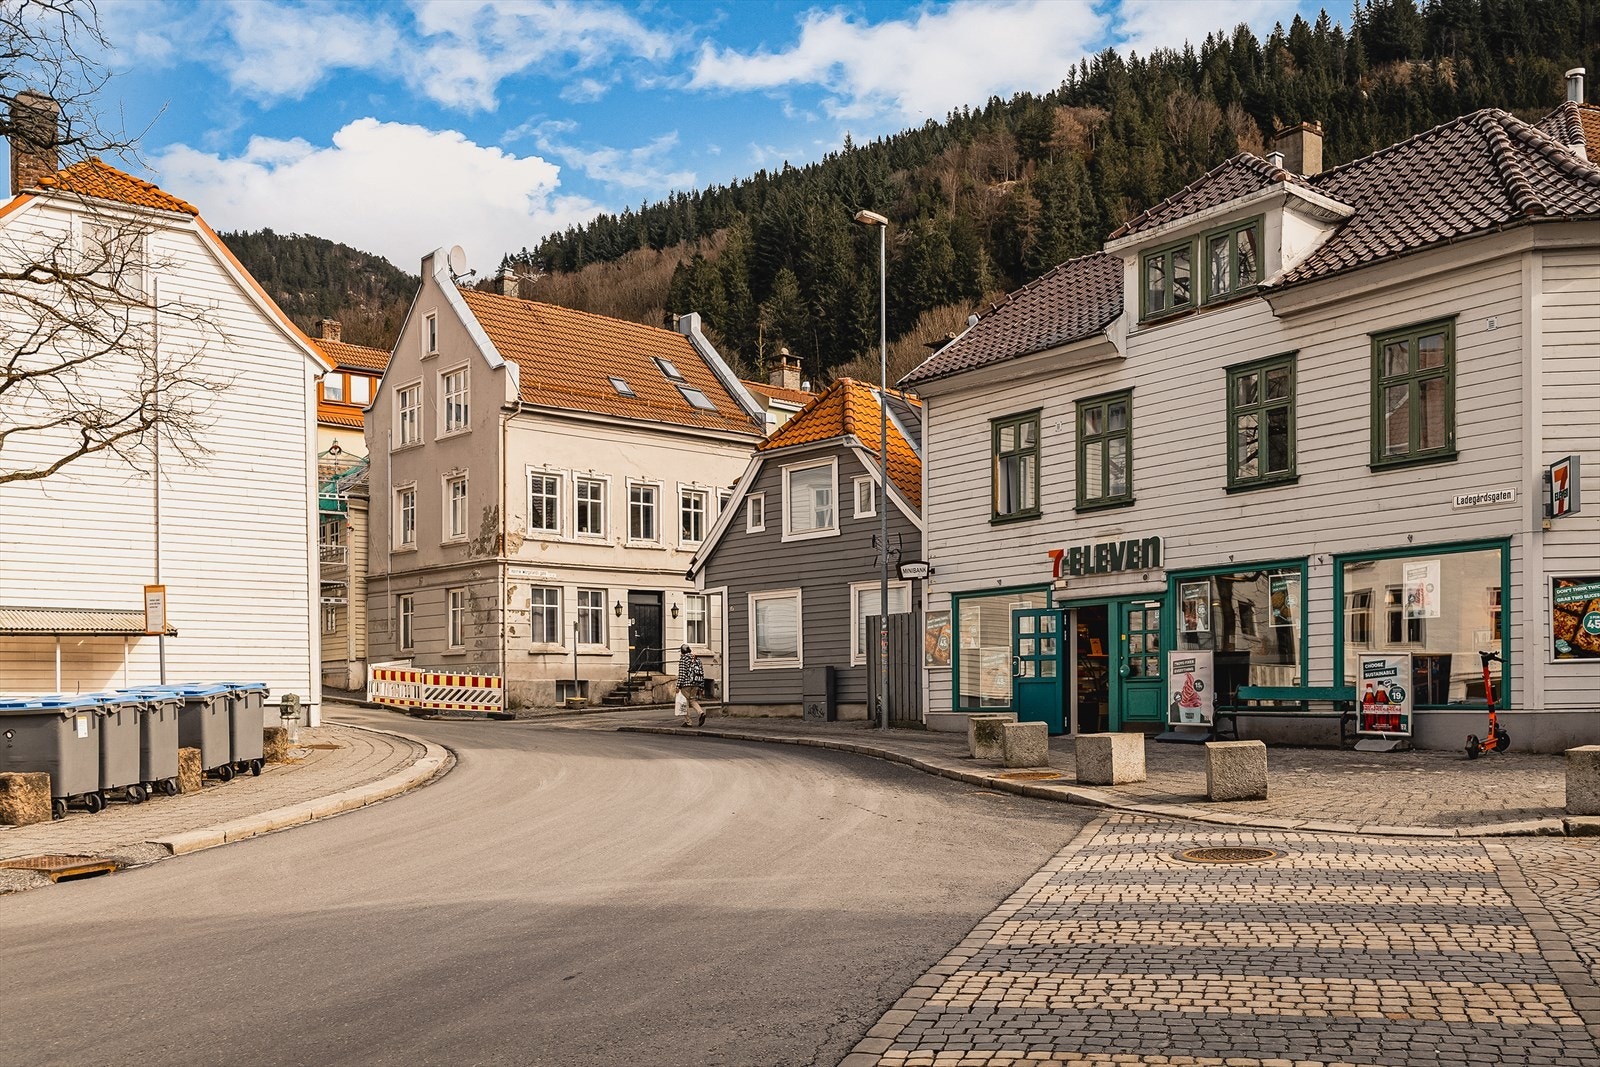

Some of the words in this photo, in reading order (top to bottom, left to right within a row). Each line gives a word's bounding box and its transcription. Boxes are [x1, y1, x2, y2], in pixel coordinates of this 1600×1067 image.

[1456, 491, 1512, 506] Ladegårdsgaten
[902, 566, 927, 574] MINIBANK
[1365, 670, 1395, 678] SUSTAINABLE
